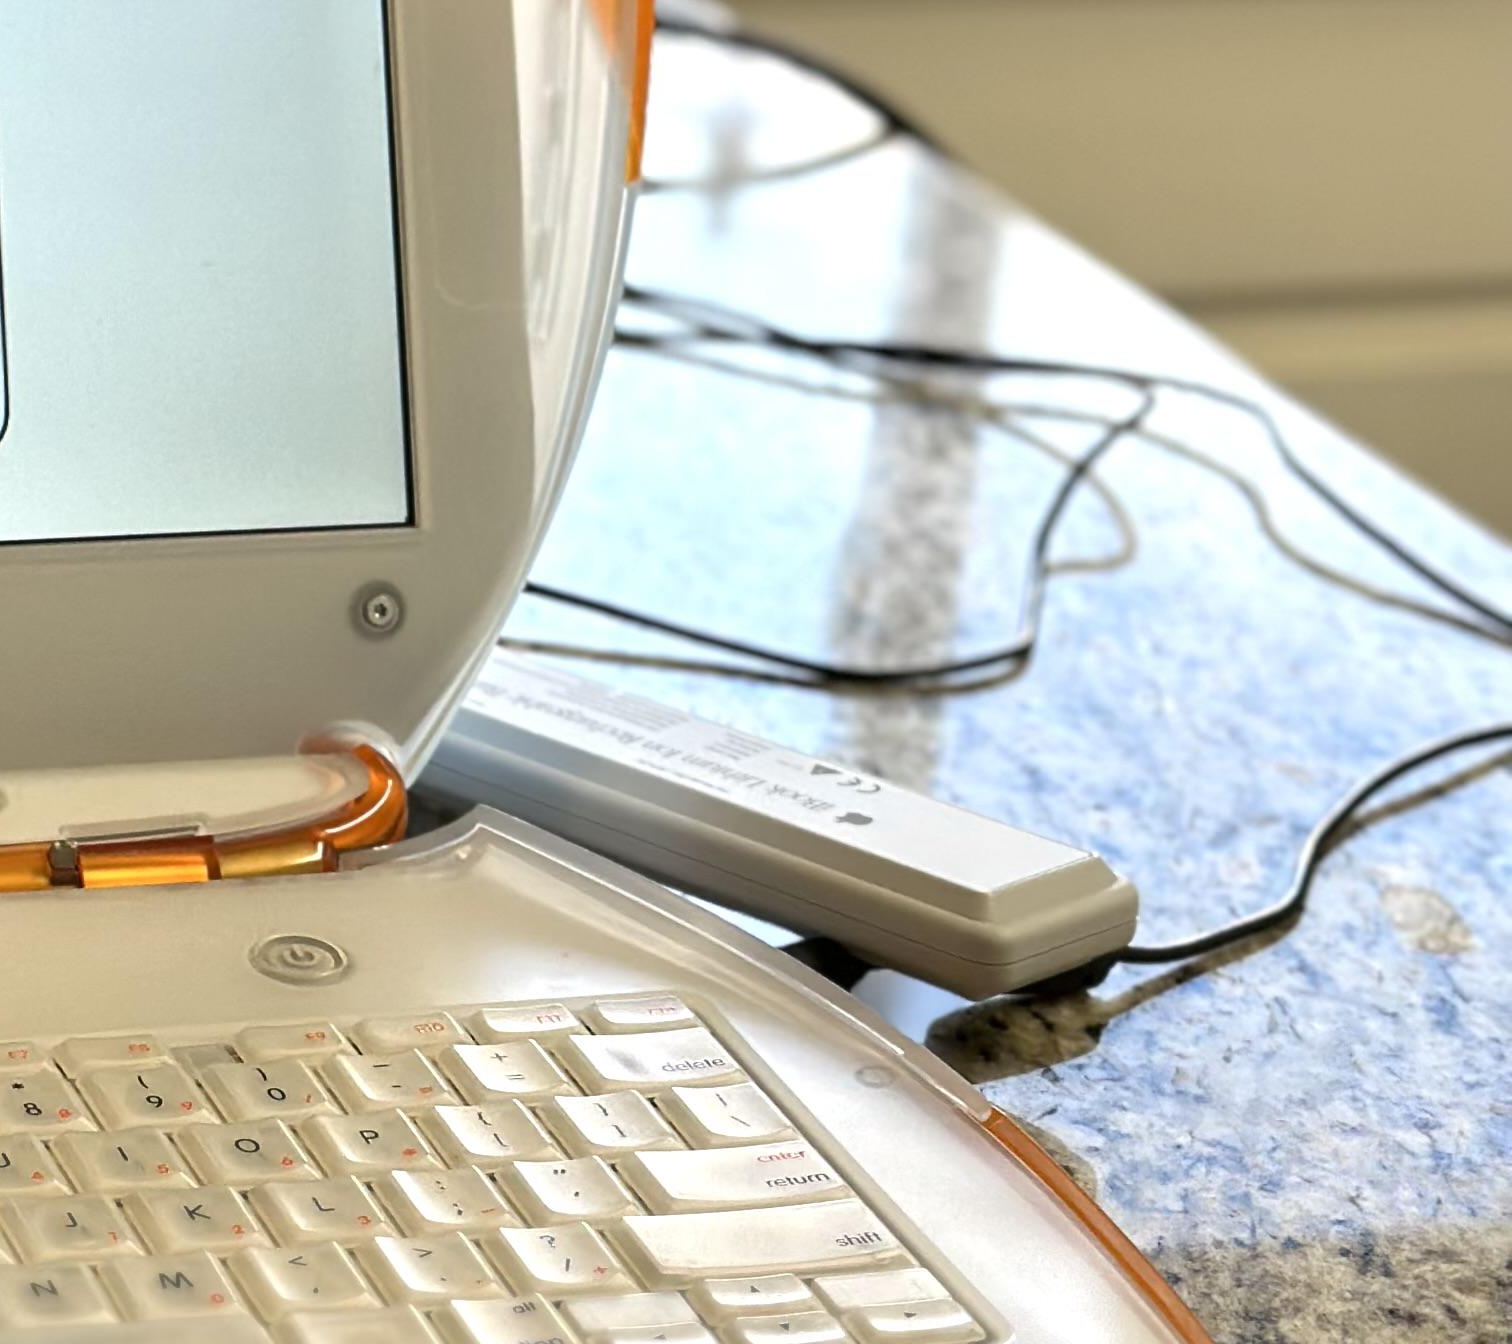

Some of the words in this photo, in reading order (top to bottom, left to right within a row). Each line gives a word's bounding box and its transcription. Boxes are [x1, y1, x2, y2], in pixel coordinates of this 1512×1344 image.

[662, 1055, 726, 1073] delete
[137, 1074, 149, 1090] (
[255, 1067, 268, 1082] )
[23, 1101, 42, 1117] 8
[145, 1094, 164, 1109] 9
[358, 1128, 380, 1145] P
[116, 1145, 129, 1162] I
[234, 1137, 262, 1154] O
[766, 1170, 831, 1189] return
[182, 1203, 213, 1221] K
[310, 1196, 337, 1213] L
[65, 1210, 80, 1228] J
[835, 1230, 883, 1249] shift
[29, 1278, 60, 1297] N
[158, 1270, 195, 1290] M
[512, 1301, 537, 1315] alt
